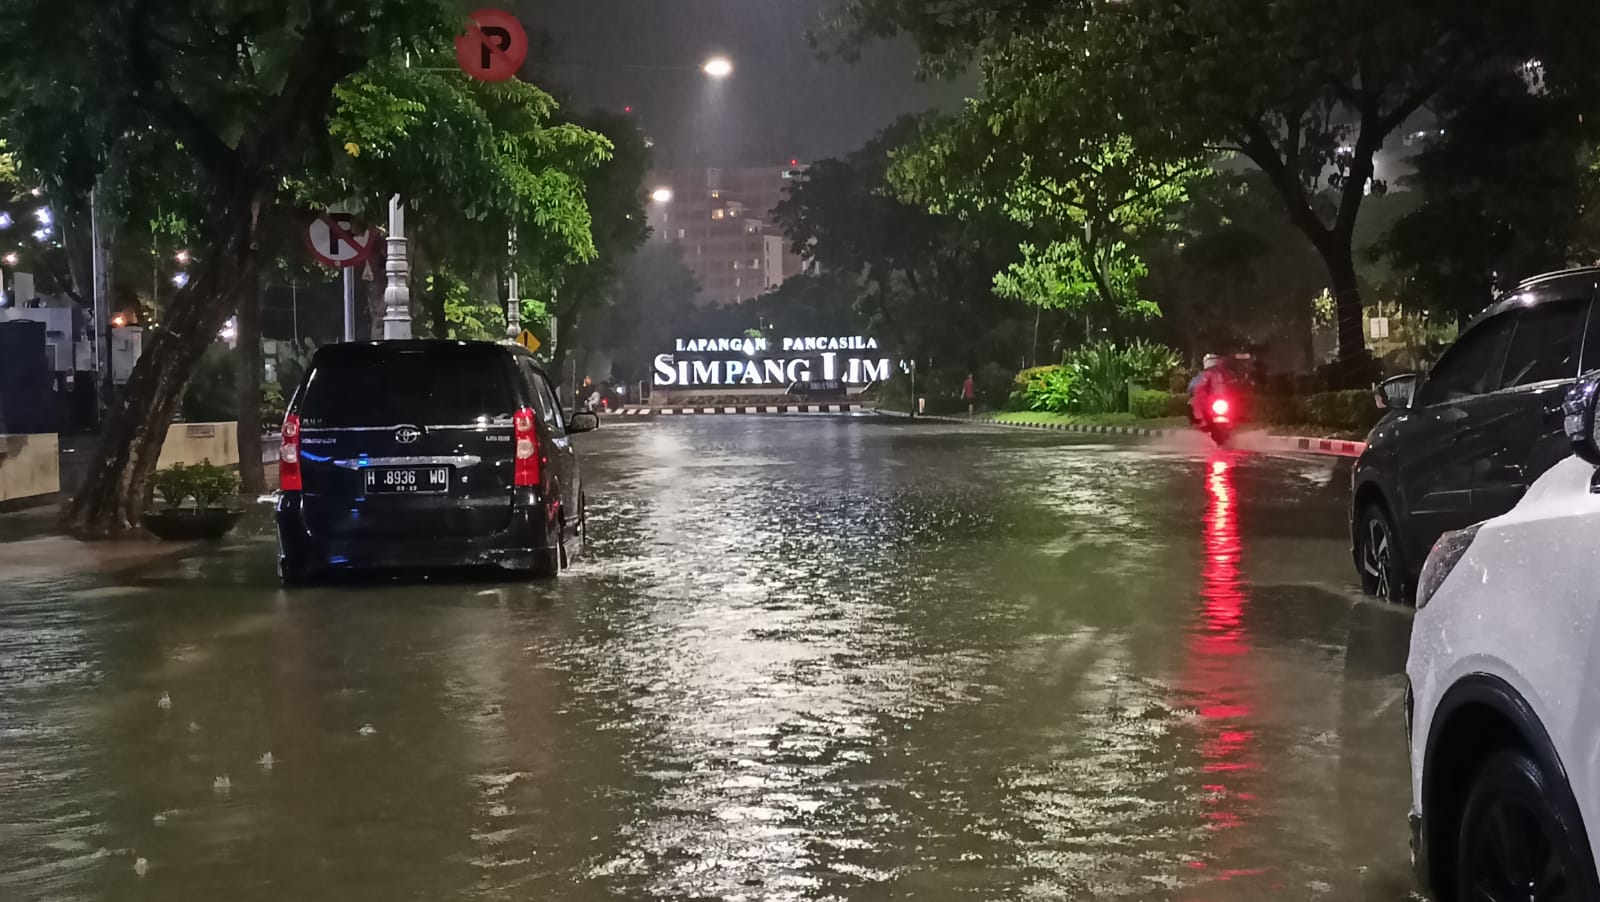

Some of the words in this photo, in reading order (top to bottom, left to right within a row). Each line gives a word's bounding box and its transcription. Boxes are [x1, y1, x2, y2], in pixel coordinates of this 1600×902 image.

[481, 27, 511, 69] P
[676, 338, 767, 354] LAPANGAN
[782, 336, 877, 350] PANCASILA
[653, 353, 810, 385] SIMPANG
[366, 472, 375, 485] H
